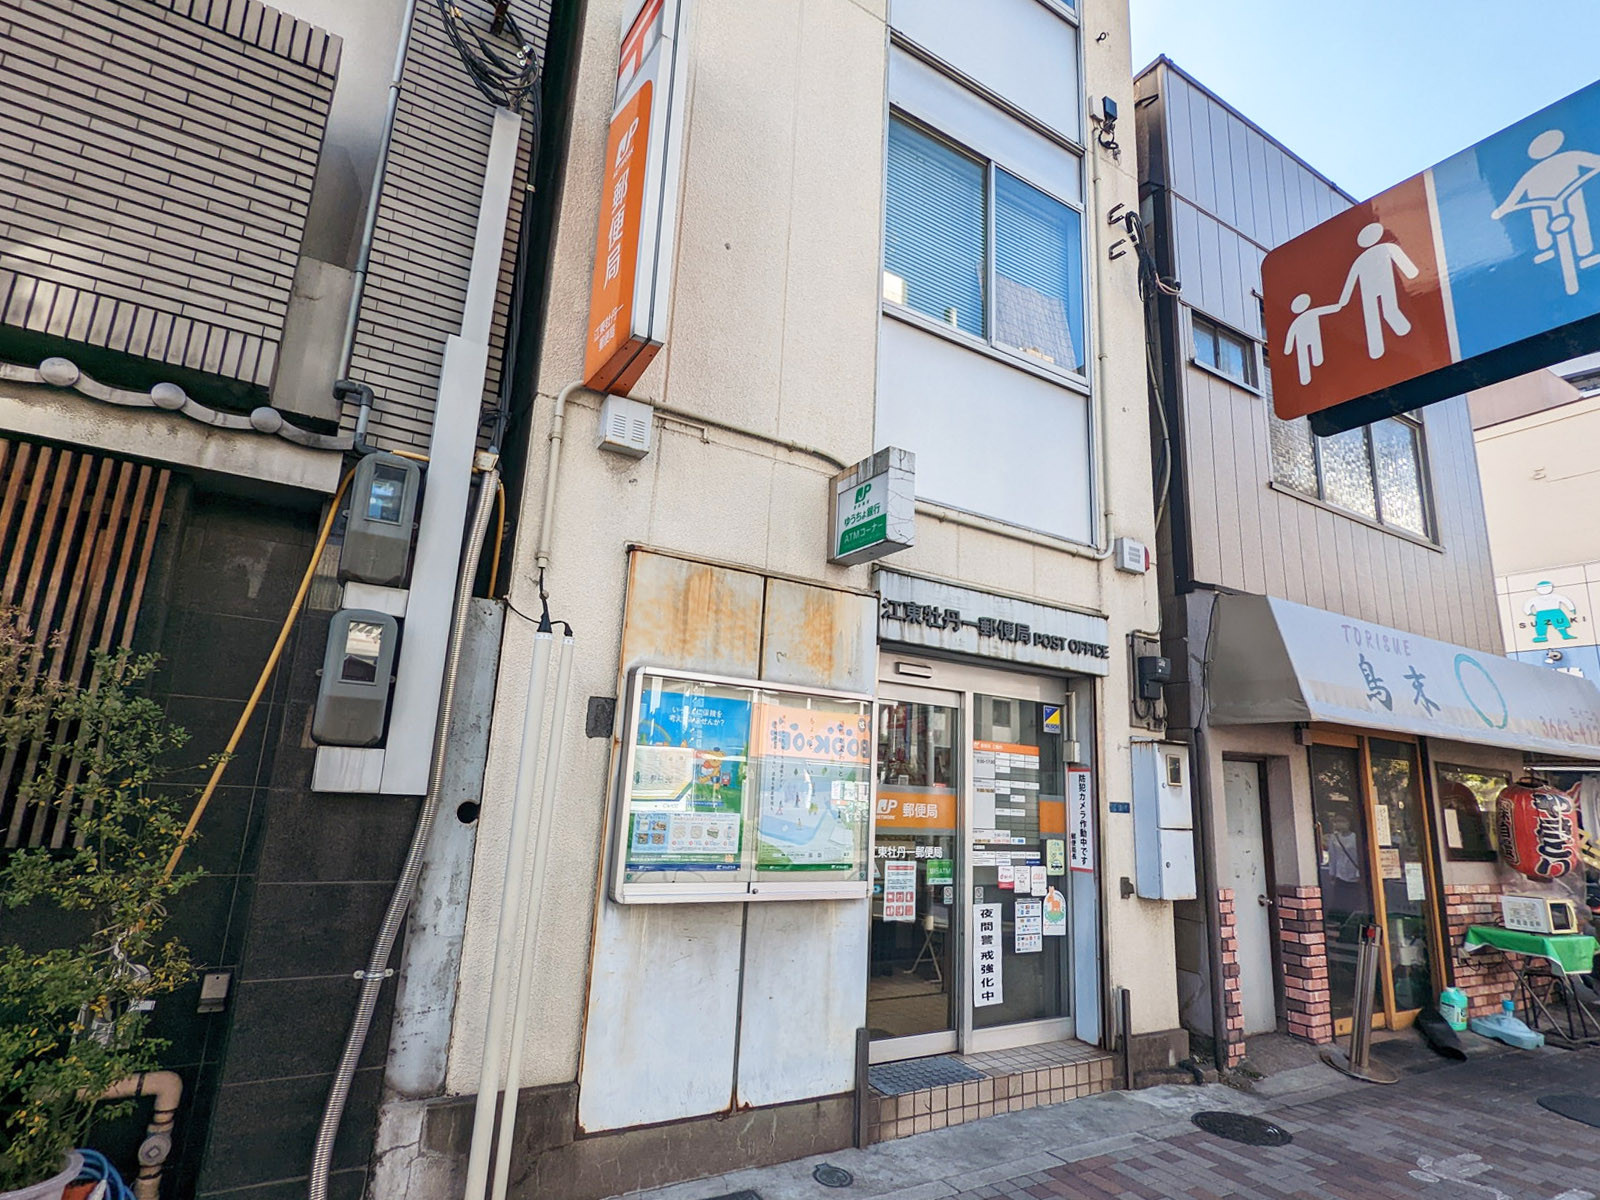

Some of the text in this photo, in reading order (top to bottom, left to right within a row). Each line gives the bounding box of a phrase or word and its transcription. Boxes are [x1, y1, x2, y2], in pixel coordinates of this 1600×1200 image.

[603, 167, 629, 290] 郵便局
[855, 483, 872, 504] JP
[844, 502, 881, 527] ゆうちょ銀行
[844, 522, 882, 543] ATMコーナー
[881, 597, 1110, 660] 江東牡丹一郵便局 POST OFFICE
[1519, 616, 1587, 629] SUZUKI
[1341, 624, 1411, 657] TORISUE
[876, 798, 898, 813] JP
[902, 802, 938, 819] 郵便局
[1078, 773, 1088, 867] 防犯カメラ作動中です
[980, 907, 995, 1002] 夜間警戒強化中
